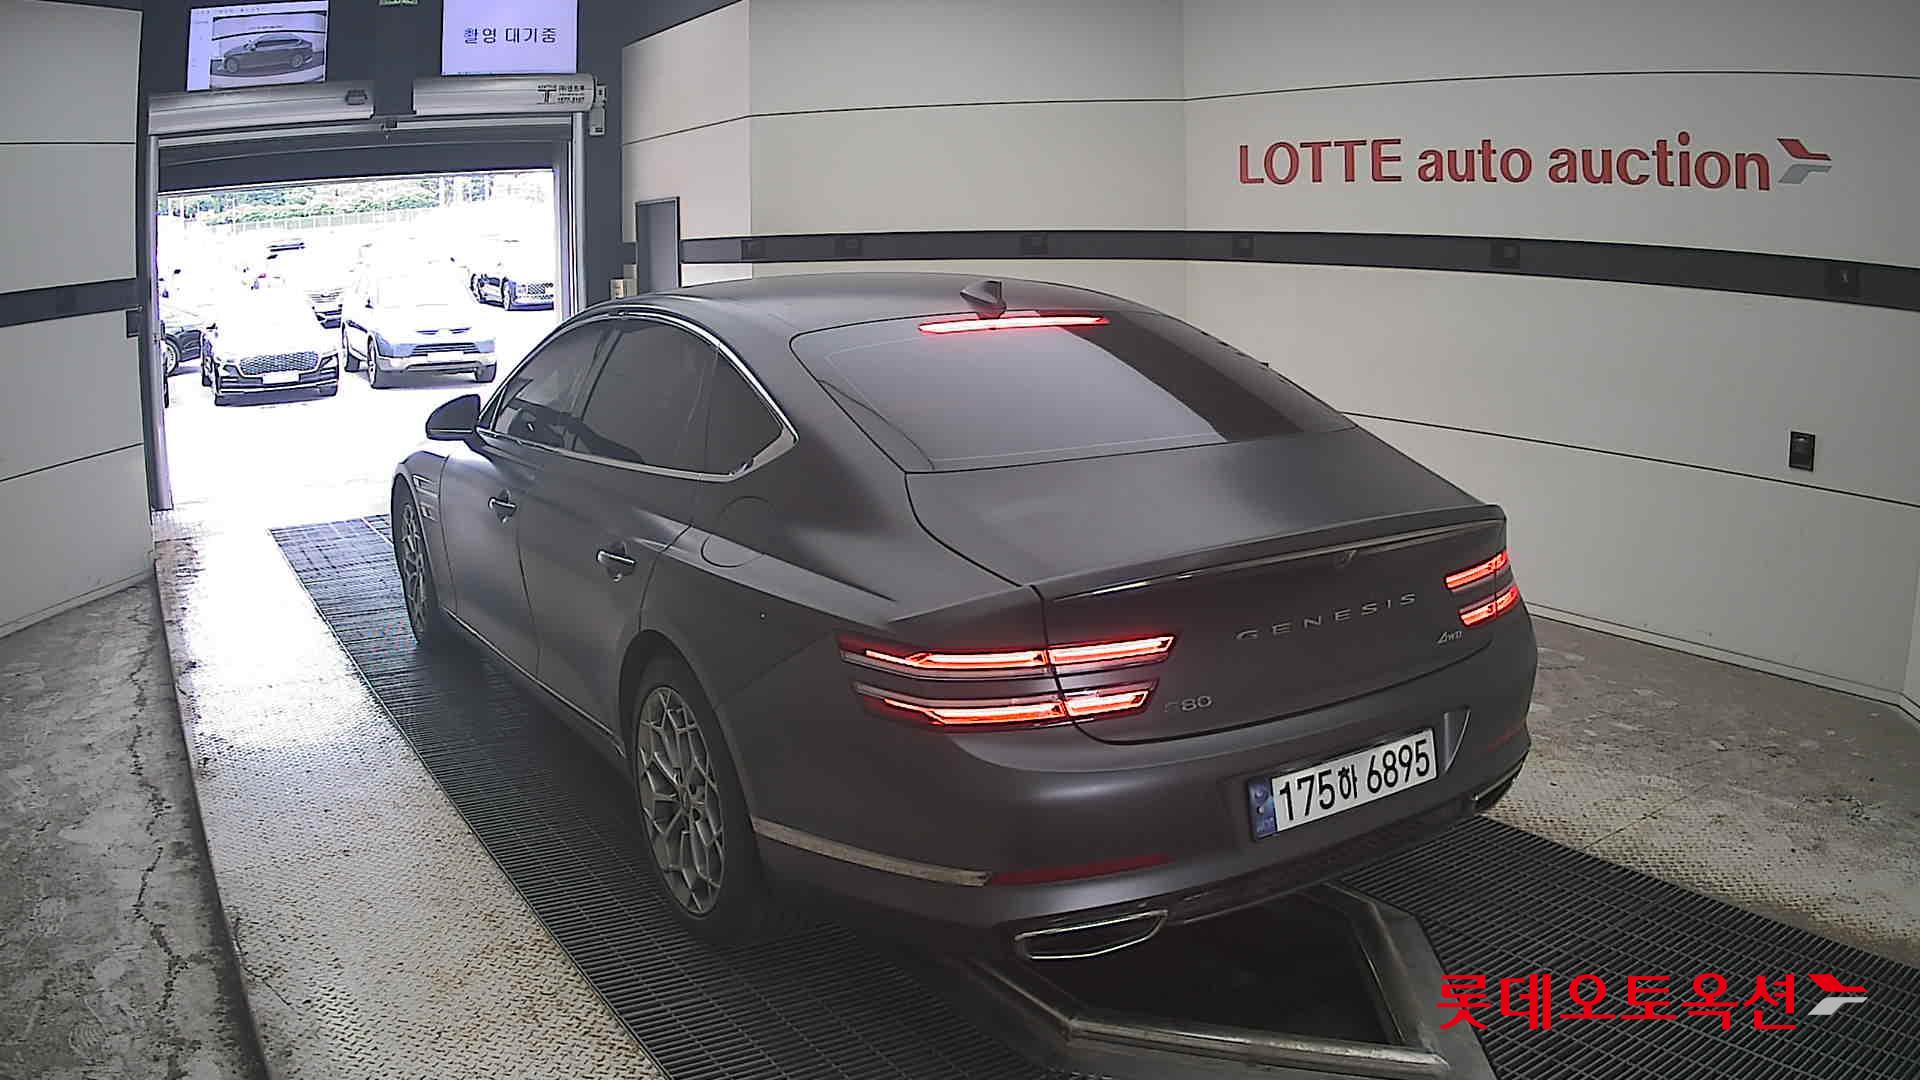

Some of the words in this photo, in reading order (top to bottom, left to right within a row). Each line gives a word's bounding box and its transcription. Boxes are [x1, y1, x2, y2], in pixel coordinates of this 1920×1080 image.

[463, 27, 497, 45] 촬영
[504, 27, 557, 44] 대기중
[1239, 139, 1402, 184] LOTTE
[1417, 138, 1533, 183] auto
[1548, 131, 1770, 191] auction
[1236, 593, 1417, 640] GENESIS
[1278, 763, 1358, 821] 175하
[1365, 738, 1431, 796] 6895
